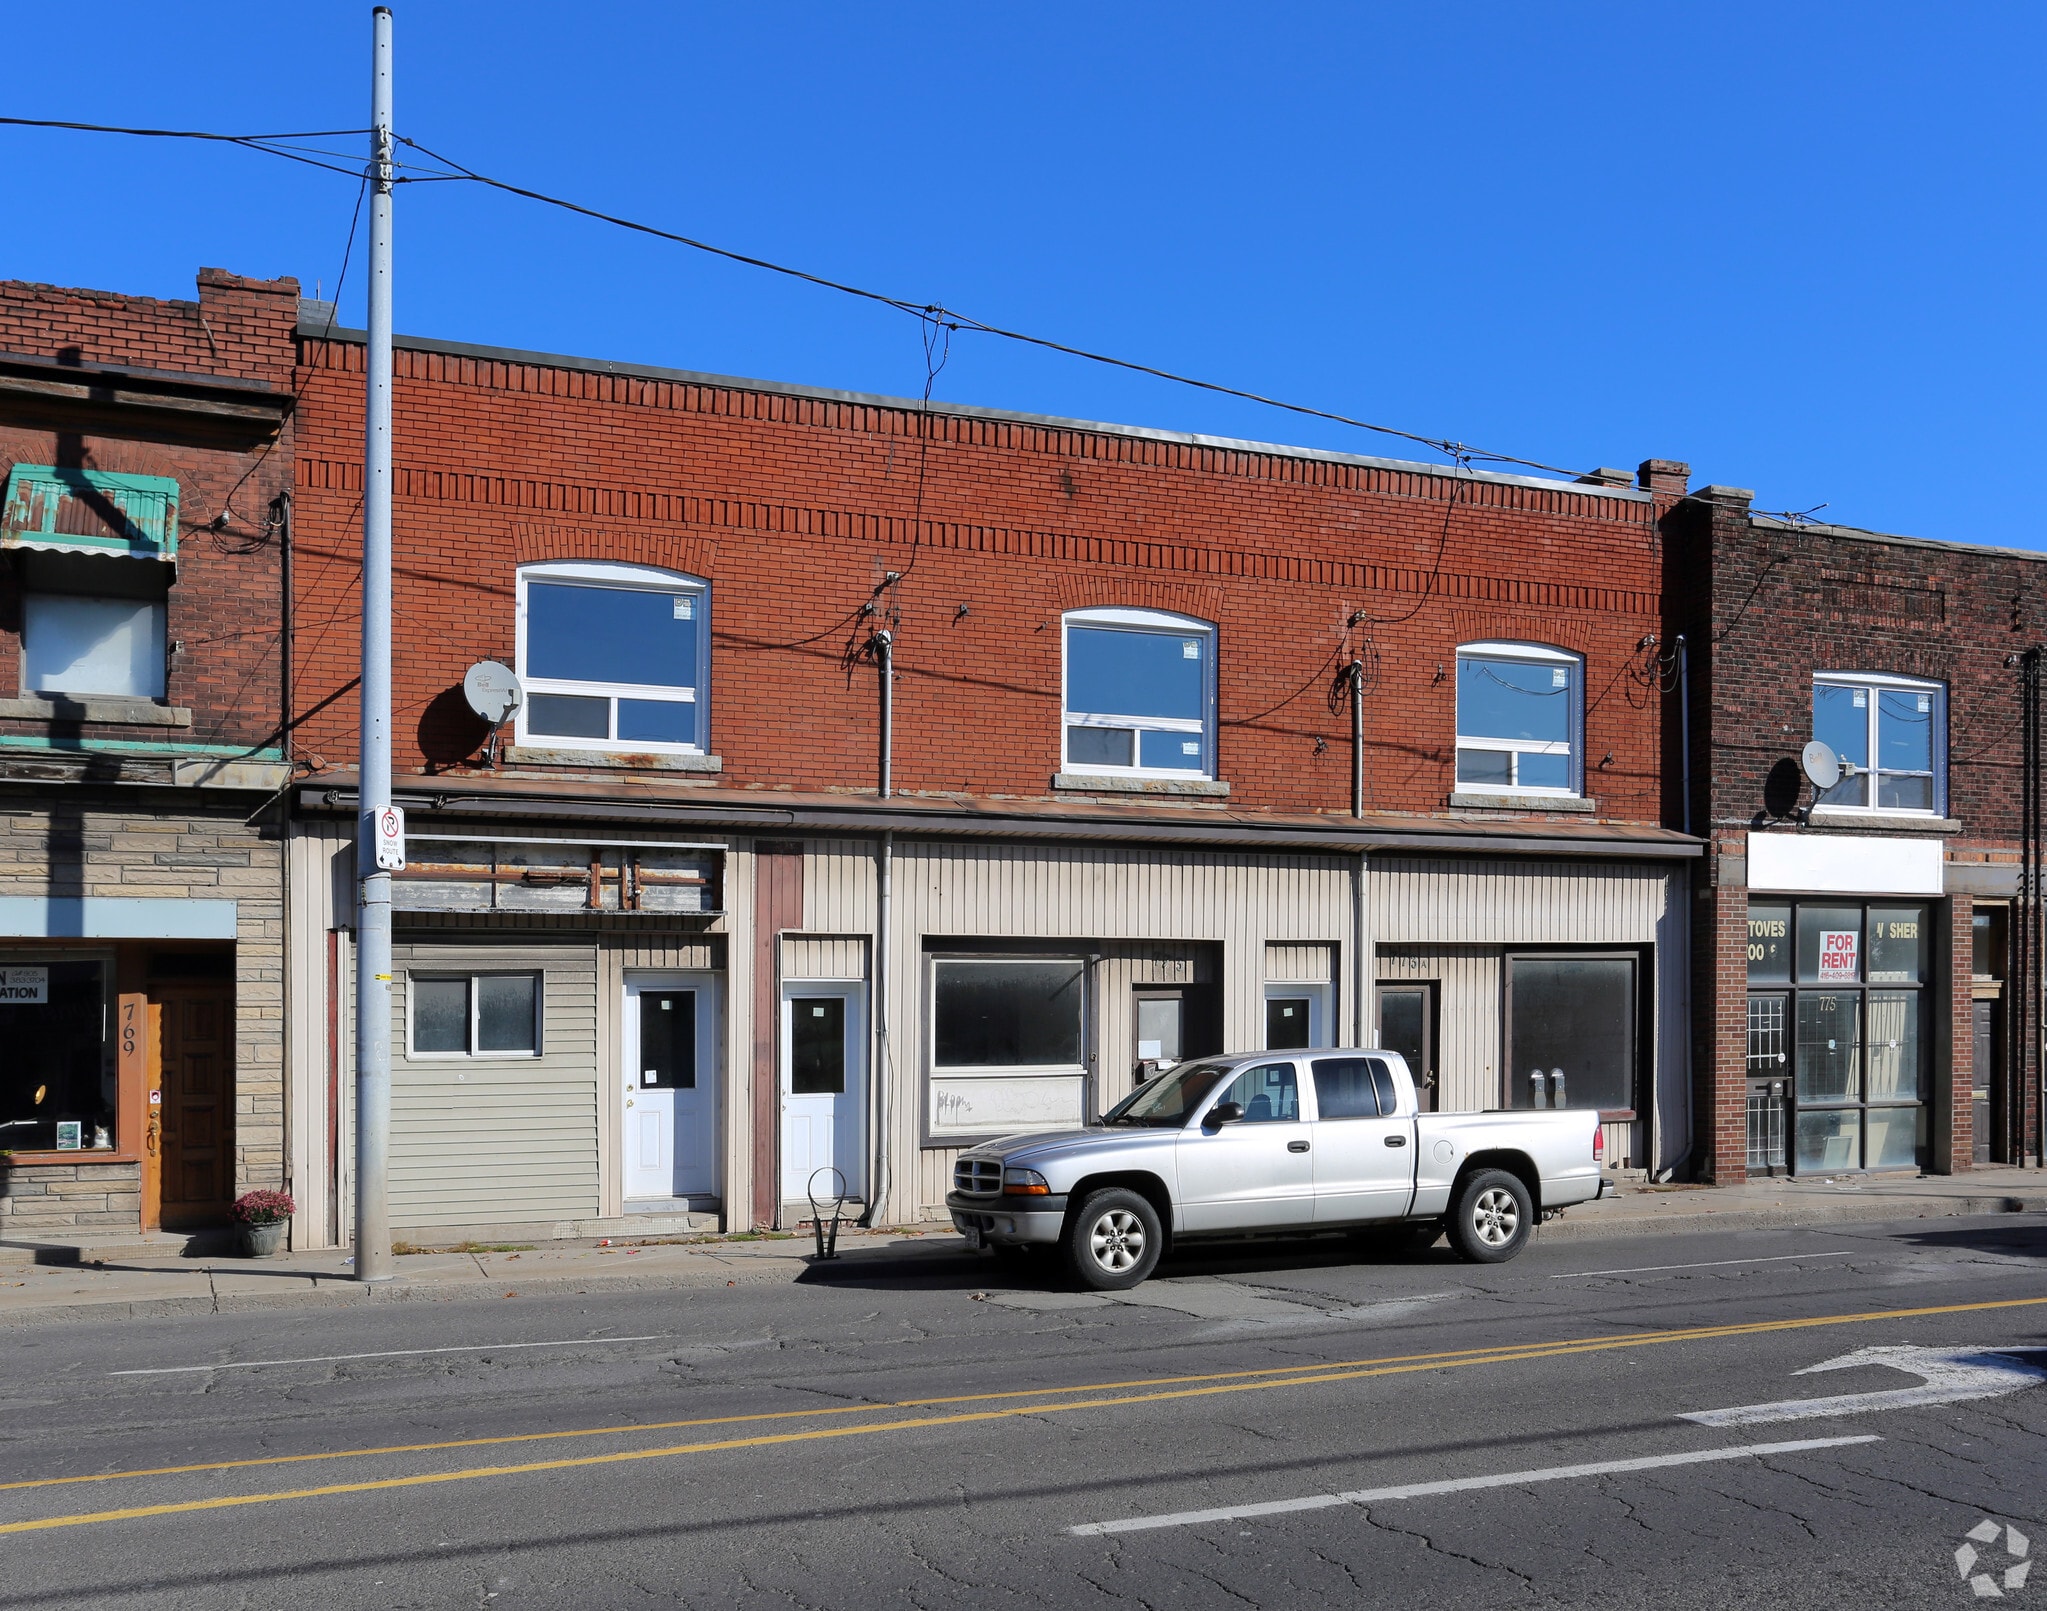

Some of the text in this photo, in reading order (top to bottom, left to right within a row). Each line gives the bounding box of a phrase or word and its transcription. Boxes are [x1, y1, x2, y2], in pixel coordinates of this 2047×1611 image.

[383, 839, 398, 847] SNOW
[383, 847, 399, 856] ROUTE
[1826, 934, 1854, 951] FOR
[1821, 952, 1856, 969] RENT
[1820, 996, 1837, 1012] 775
[123, 1003, 136, 1058] 769
